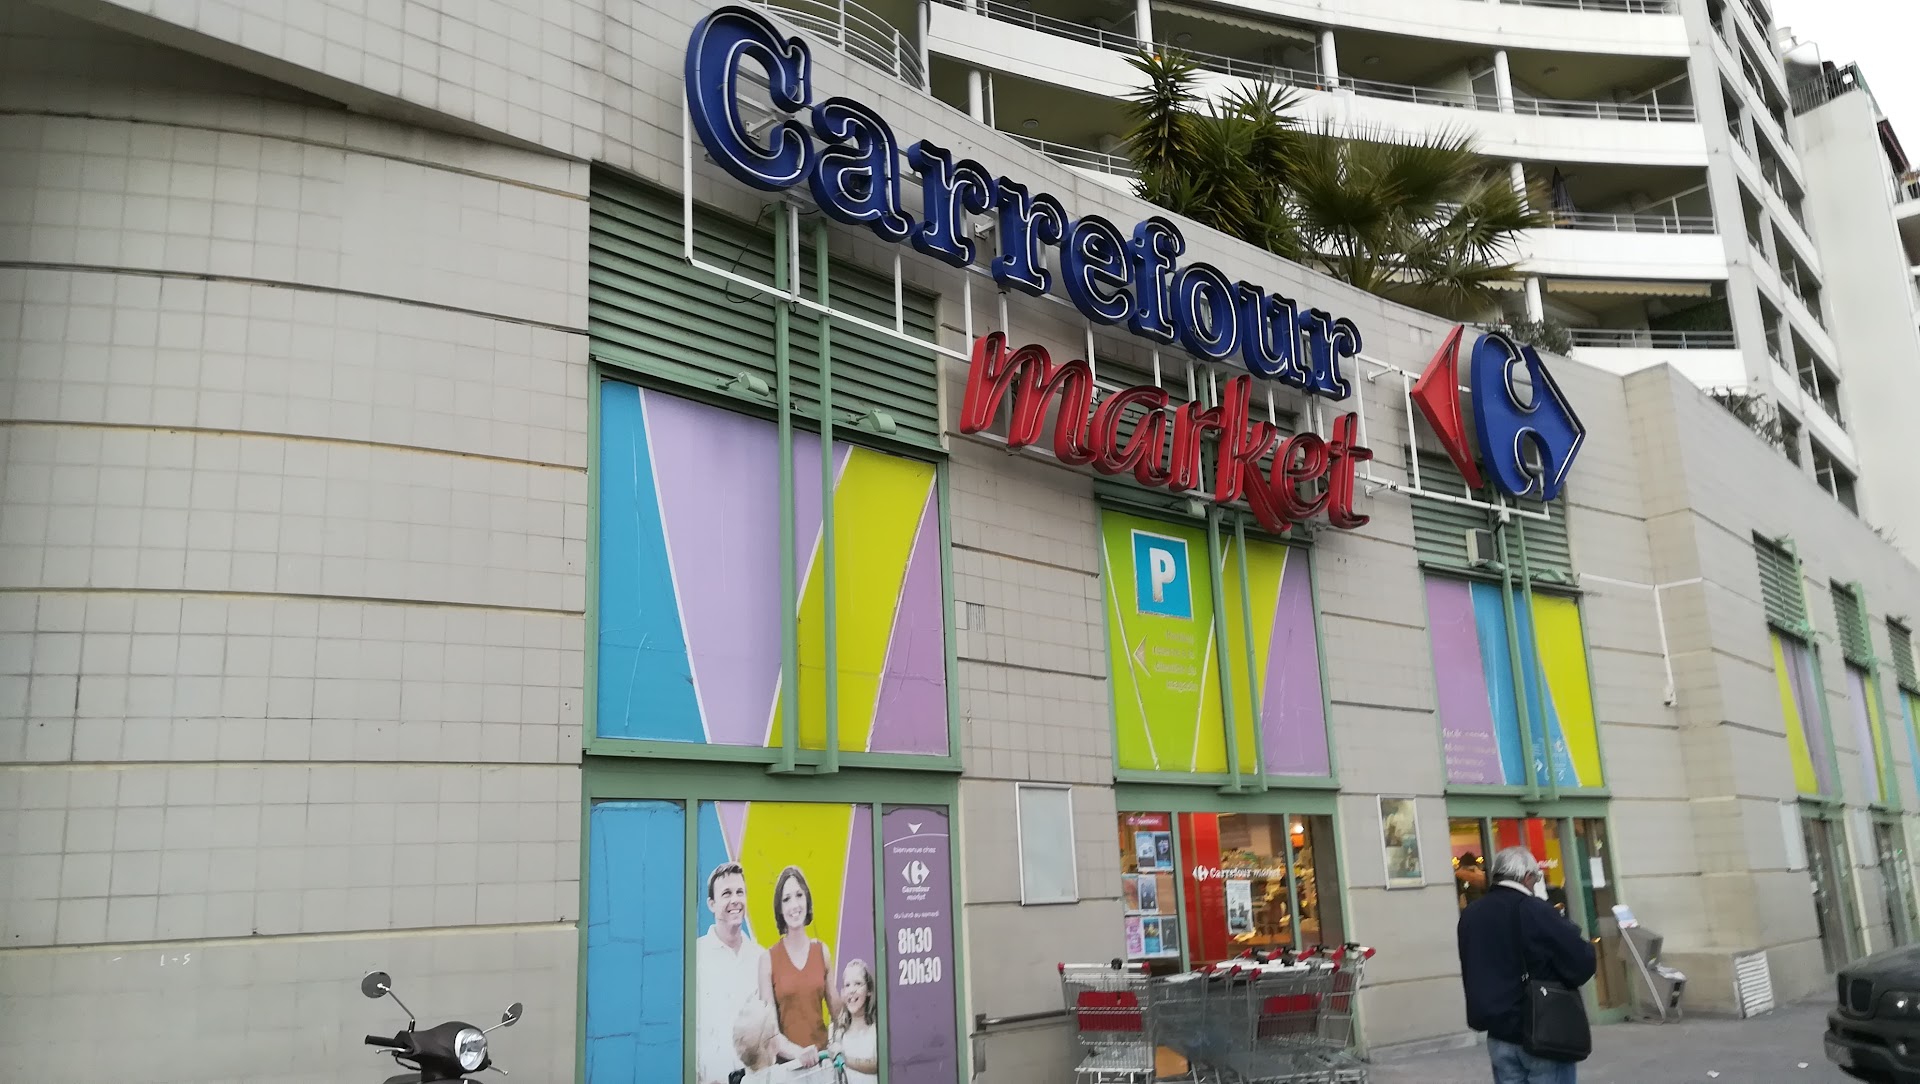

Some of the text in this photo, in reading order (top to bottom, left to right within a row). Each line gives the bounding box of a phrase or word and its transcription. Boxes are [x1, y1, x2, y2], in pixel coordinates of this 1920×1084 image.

[685, 4, 1362, 400] Carrefour
[959, 331, 1374, 534] market
[1149, 547, 1176, 603] P
[1209, 866, 1251, 879] Carrefour
[901, 885, 931, 894] Carrefour
[898, 926, 932, 955] 8h30
[899, 956, 942, 986] 20h30
